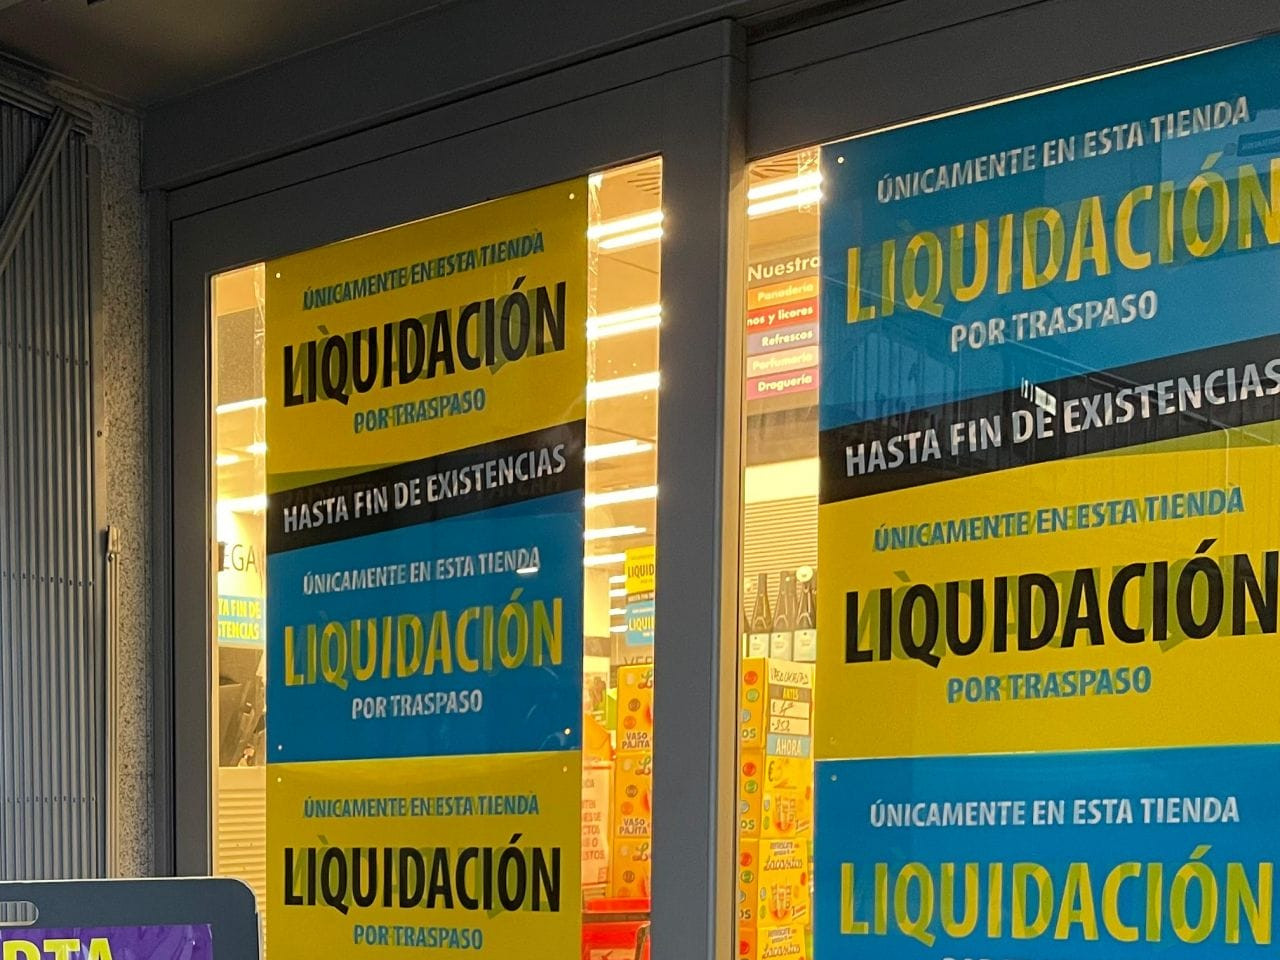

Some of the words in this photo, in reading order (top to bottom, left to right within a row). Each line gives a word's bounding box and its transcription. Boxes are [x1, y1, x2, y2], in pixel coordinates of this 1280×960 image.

[877, 149, 1035, 203] ÚNICAMENTE
[1043, 138, 1075, 167] EN
[1083, 122, 1144, 156] ESTA
[1151, 95, 1249, 143] TIENDA
[846, 152, 1280, 324] LIQUIDACIÓN
[303, 267, 406, 311] ÚNICAMENTE
[411, 262, 431, 284] EN
[436, 250, 476, 277] ESTA
[480, 231, 544, 266] TIENDA
[283, 275, 567, 407] LIQUIDACIÓN
[747, 315, 765, 327] nos
[768, 314, 775, 325] y
[778, 305, 813, 321] licores
[762, 330, 813, 347] Refrescos
[951, 319, 1006, 352] POR
[1012, 290, 1158, 341] TRASPASO
[354, 411, 388, 434] POR
[393, 388, 486, 425] TRASPASO
[758, 374, 812, 392] Droguería
[846, 429, 941, 476] HASTA
[951, 414, 1001, 456] FIN
[1012, 407, 1054, 443] DE
[1063, 358, 1280, 433] EXISTENCIAS
[284, 496, 349, 533] HASTA
[354, 485, 387, 519] FIN
[394, 478, 421, 509] DE
[426, 444, 567, 502] EXISTENCIAS
[873, 513, 1028, 552] ÚNICAMENTE
[1036, 508, 1068, 533] EN
[1076, 499, 1137, 529] ESTA
[1144, 485, 1245, 522] TIENDA
[303, 564, 406, 595] ÚNICAMENTE
[410, 561, 431, 583] EN
[435, 556, 474, 580] ESTA
[478, 547, 540, 575] TIENDA
[628, 563, 654, 578] LIQUID
[844, 538, 1279, 668] LIQUIDACIÓN
[284, 587, 563, 689] LIQUIDACIÓN
[351, 697, 386, 719] POR
[390, 689, 482, 715] TRASPASO
[947, 675, 1000, 703] POR
[1008, 665, 1152, 700] TRASPASO
[304, 796, 406, 818] ÚNICAMENTE
[410, 797, 431, 816] EN
[435, 796, 474, 815] ESTA
[478, 793, 539, 815] TIENDA
[870, 799, 1025, 828] ÚNICAMENTE
[1032, 800, 1065, 825] EN
[1072, 798, 1134, 825] ESTA
[1140, 796, 1240, 824] TIENDA
[284, 833, 561, 915] LIQUIDACIÓN
[840, 844, 1273, 947] LIQUIDACIÓN
[353, 925, 389, 945] POR
[393, 926, 483, 950] TRASPASO
